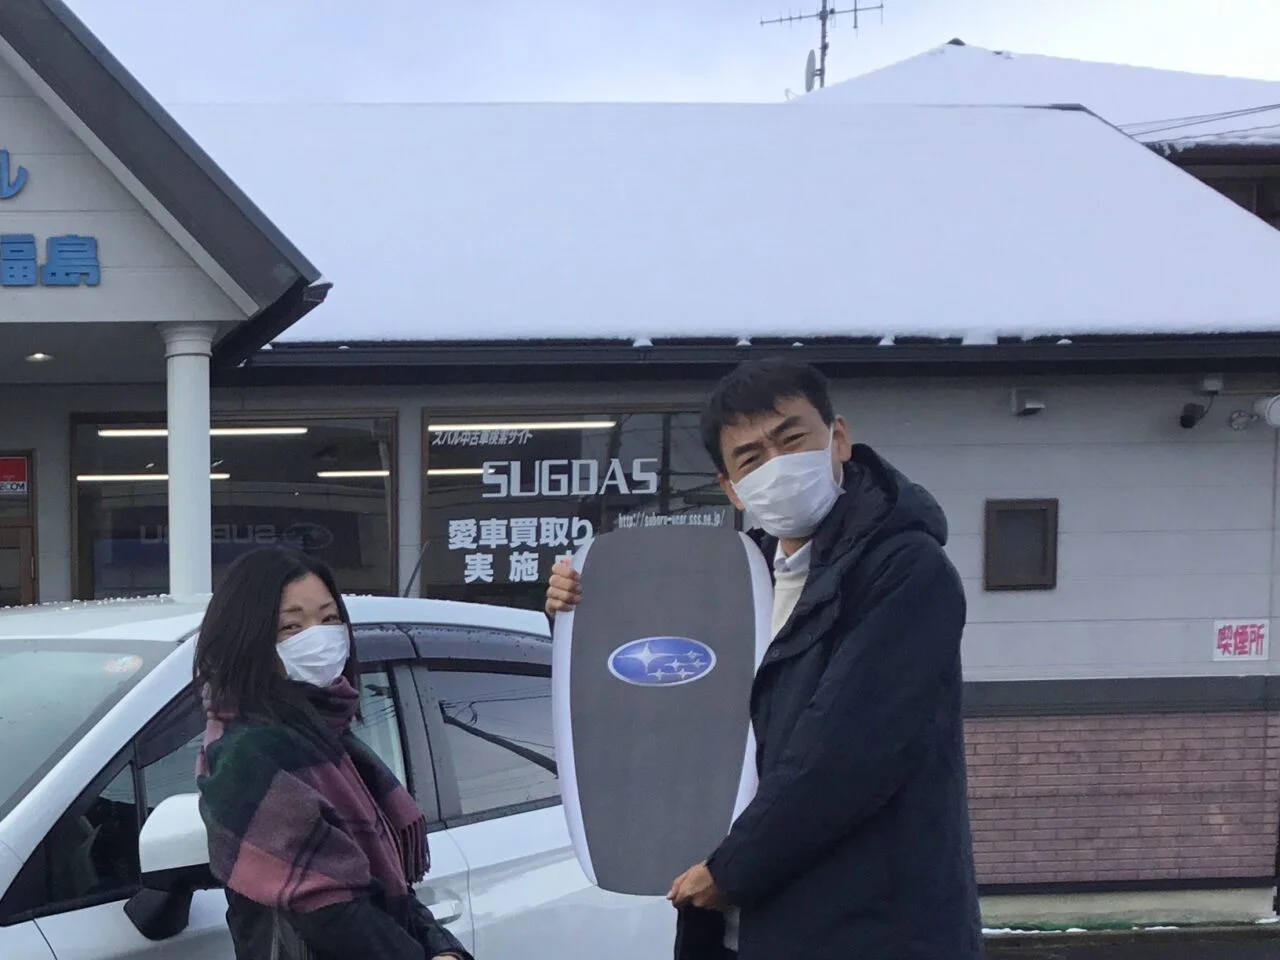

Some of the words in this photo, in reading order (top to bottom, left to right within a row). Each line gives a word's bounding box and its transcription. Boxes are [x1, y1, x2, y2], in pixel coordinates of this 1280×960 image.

[432, 429, 533, 446] スバル中古車検索サイト
[481, 457, 659, 498] SUGDAS
[448, 517, 594, 549] 愛車買取り
[1216, 623, 1265, 656] 喫煙所
